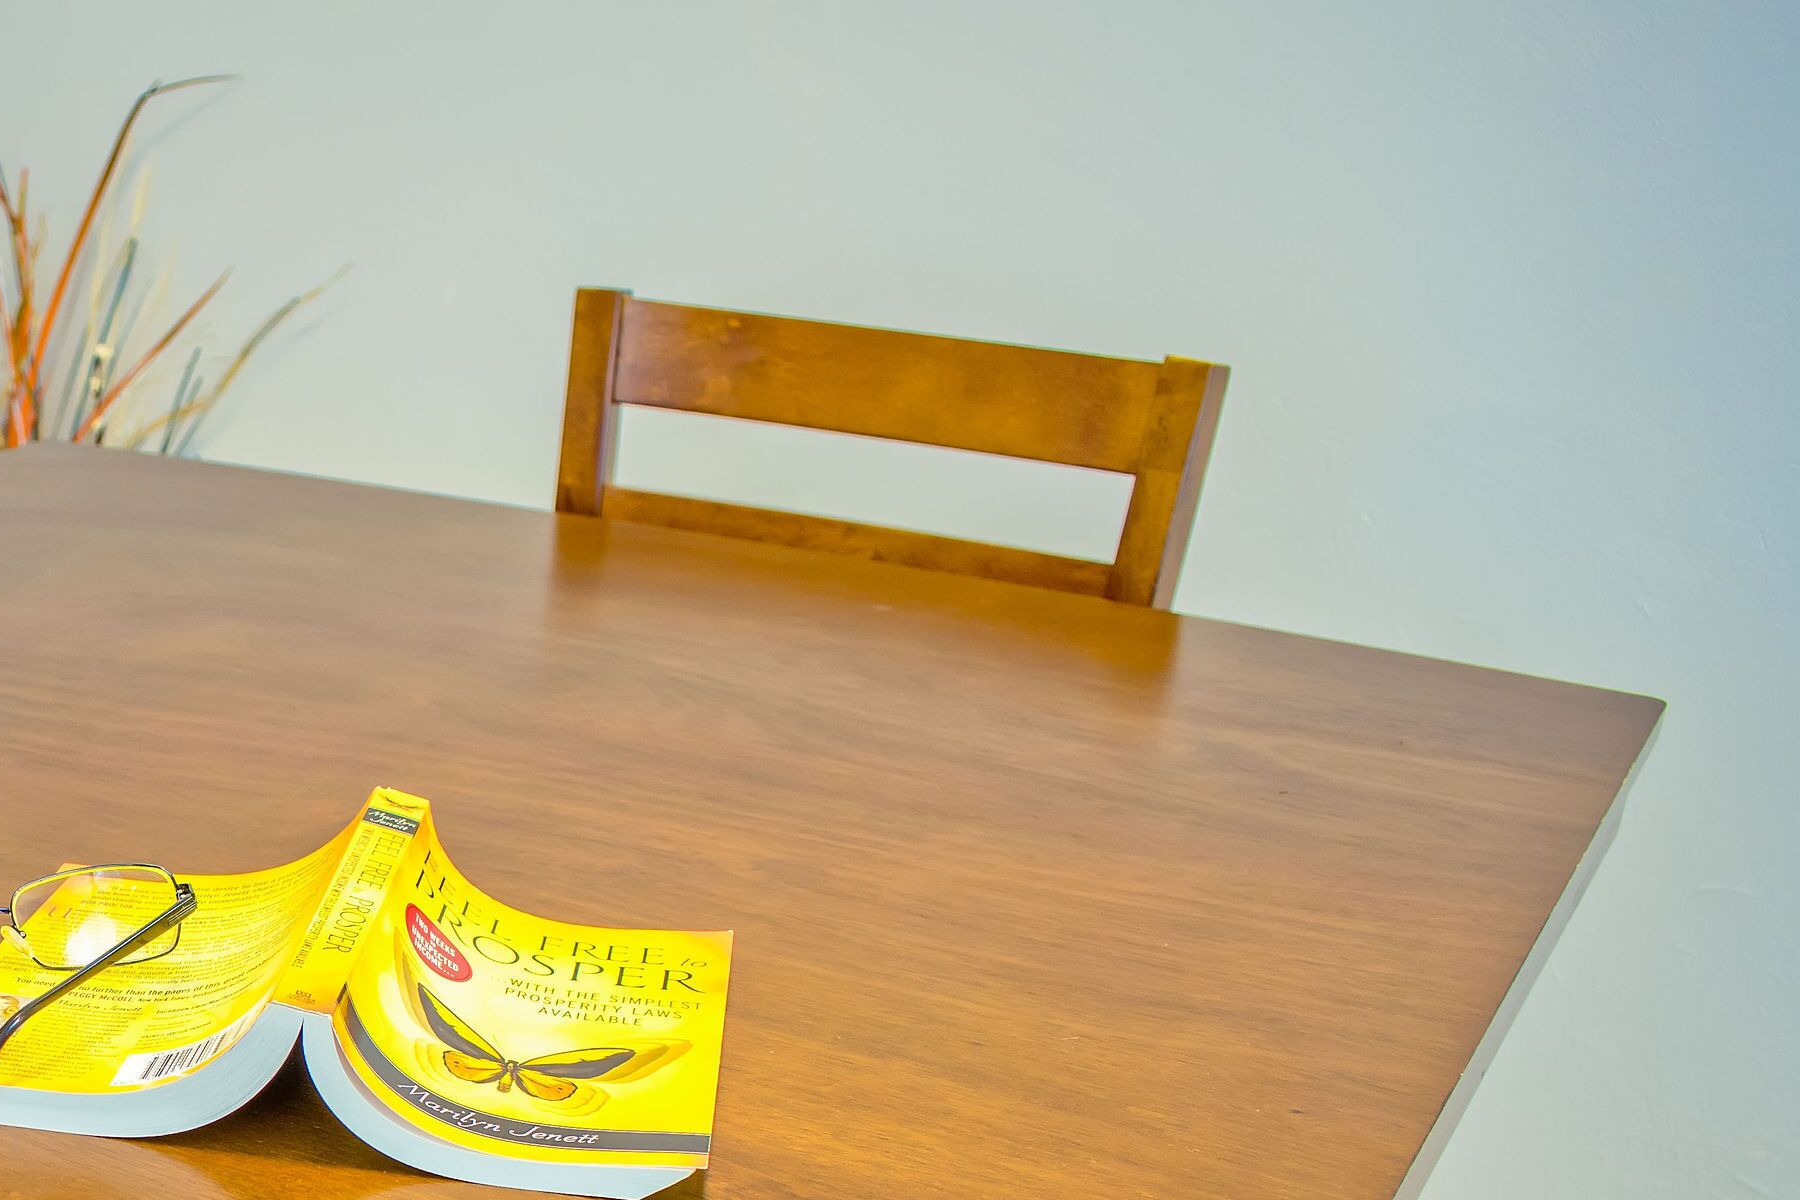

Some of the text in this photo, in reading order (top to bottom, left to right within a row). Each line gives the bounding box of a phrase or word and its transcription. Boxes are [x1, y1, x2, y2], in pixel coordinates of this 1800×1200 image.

[368, 810, 416, 828] Marilyn
[369, 817, 408, 831] Jenett
[371, 831, 406, 858] FEEL
[356, 859, 392, 890] FREE
[424, 850, 512, 941] FEEL
[539, 935, 665, 966] FREE
[322, 895, 375, 953] PROSPER
[414, 912, 456, 957] TWO WEEKS
[415, 869, 708, 994] PROSPER
[411, 924, 460, 973] UNEXPECTED
[68, 991, 96, 999] PEGGY
[92, 986, 123, 995] further
[125, 988, 146, 996] than
[164, 988, 191, 997] pages
[193, 984, 204, 992] of
[505, 987, 683, 1020] PROSPERITY LAWS
[566, 989, 600, 1002] THE
[610, 994, 703, 1011] SIMPLEST
[537, 1006, 644, 1027] AVAILABLE
[397, 1083, 600, 1145] Marilyn Jenett
